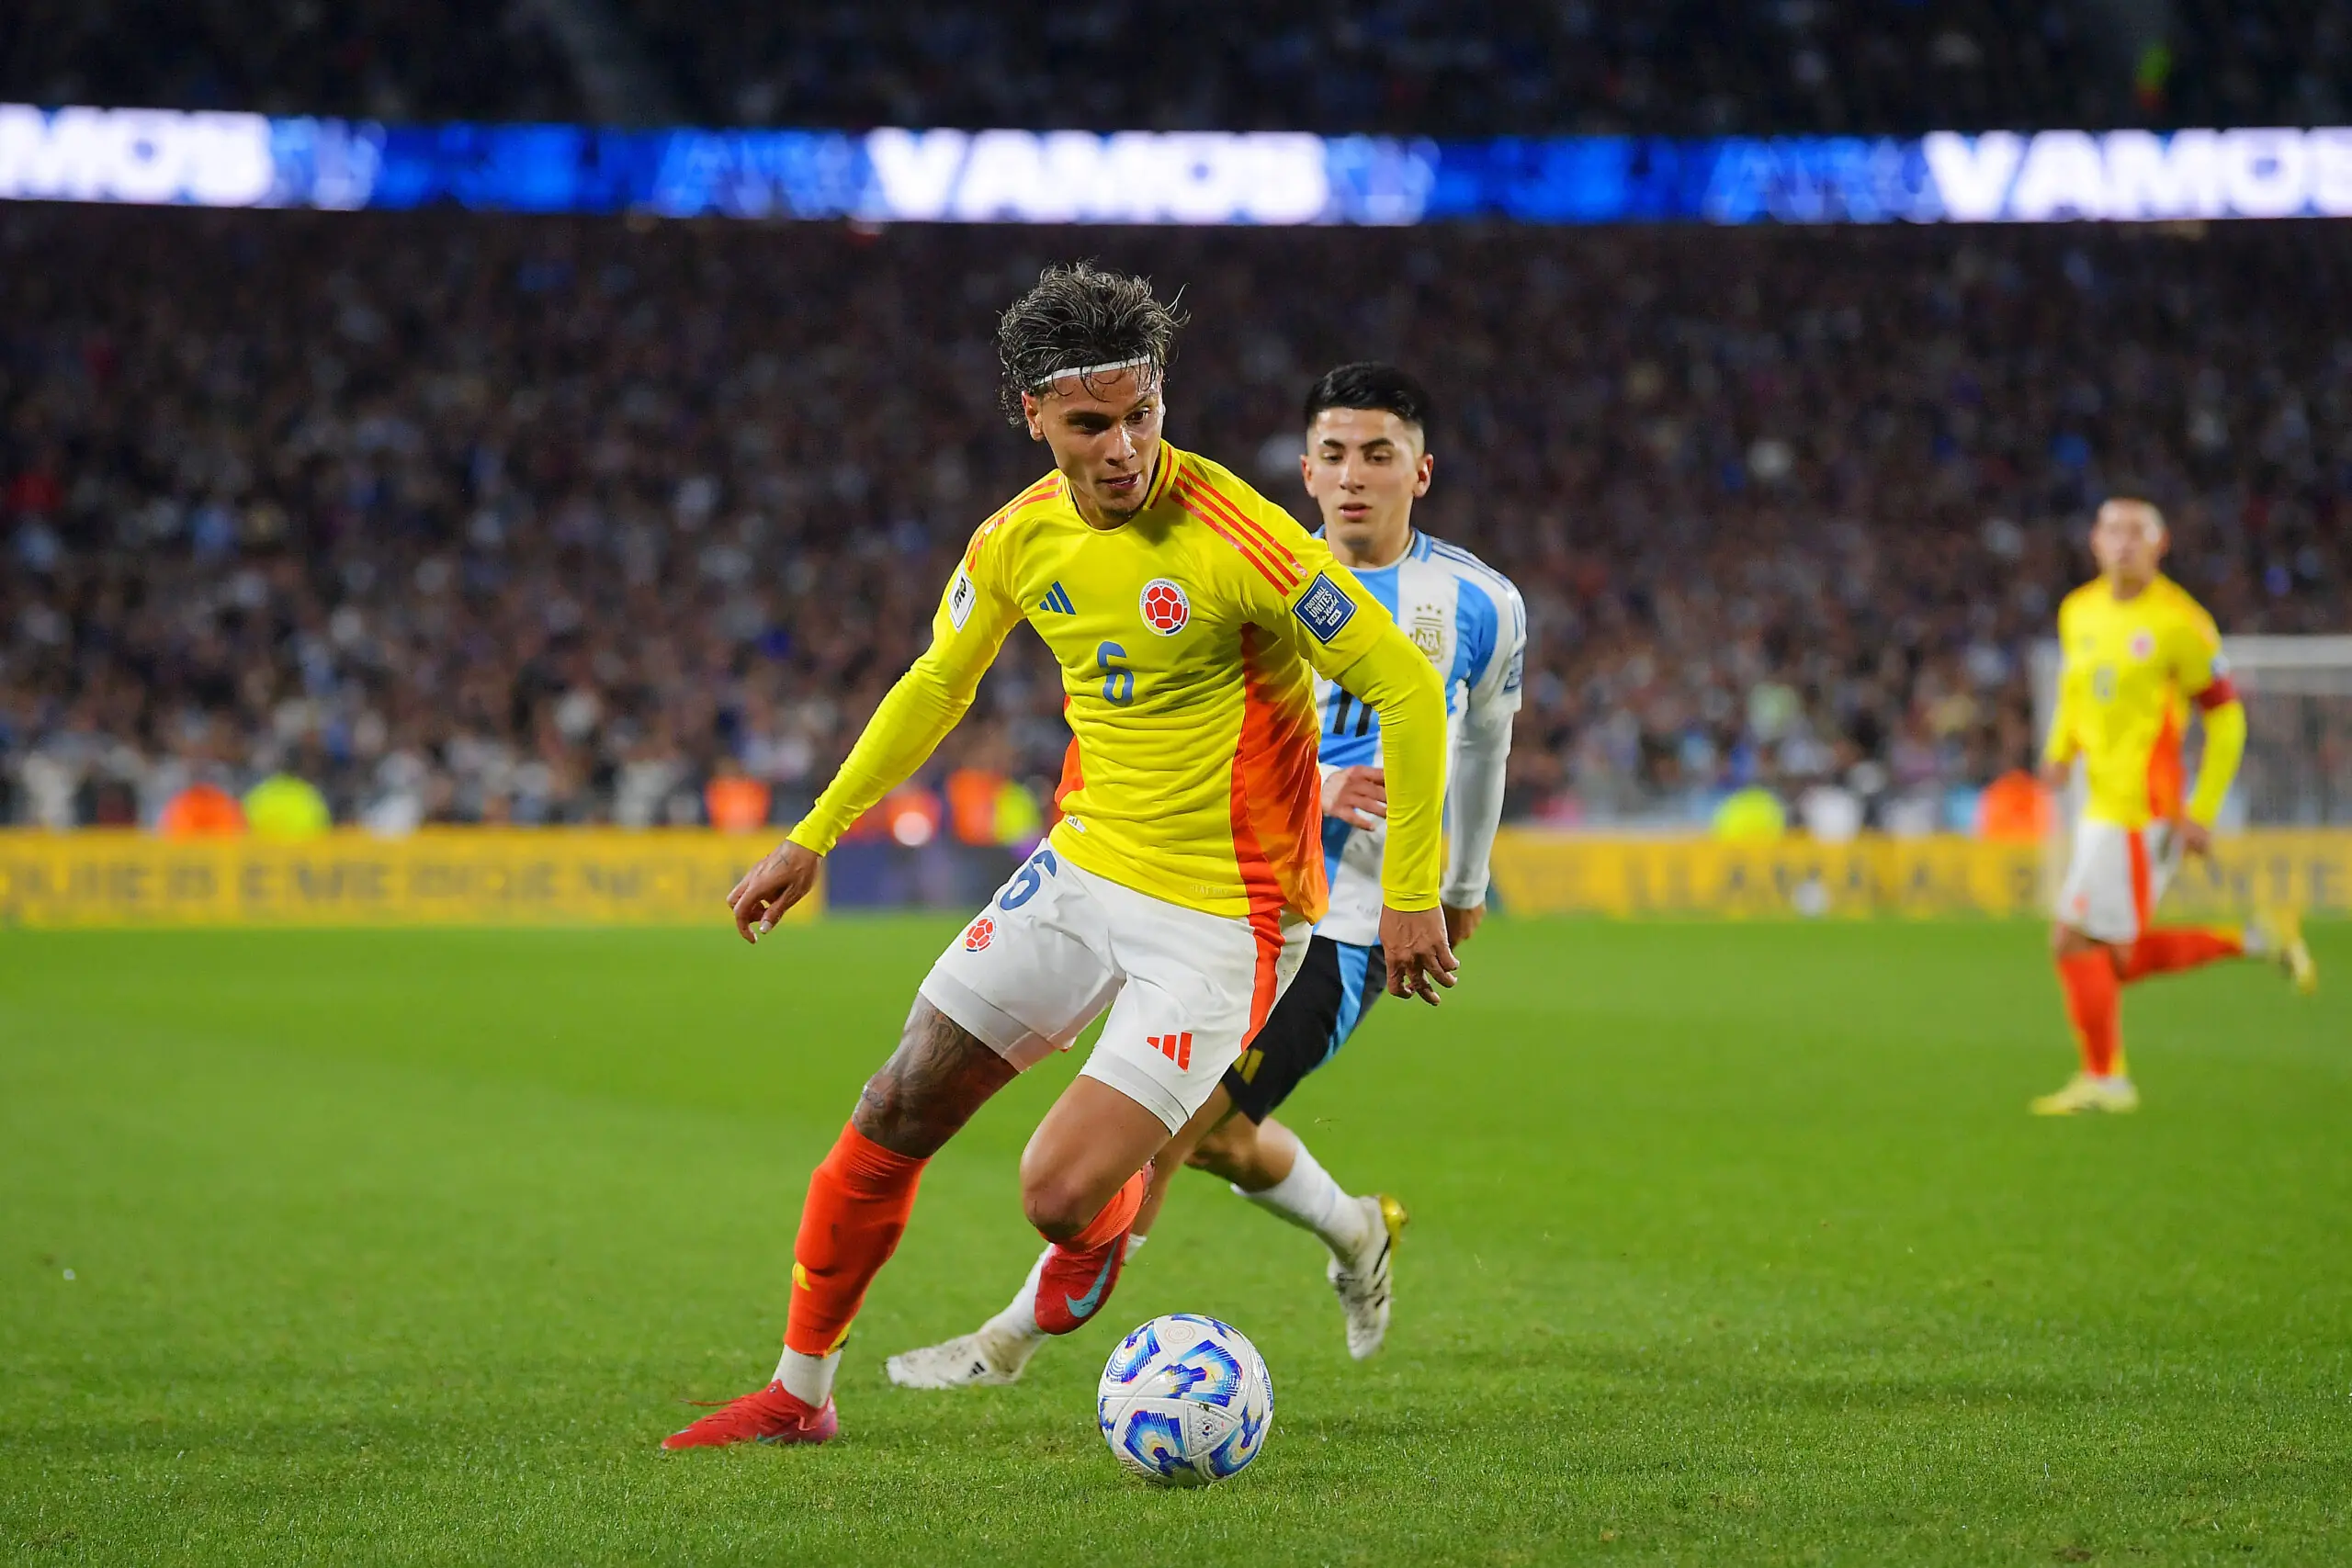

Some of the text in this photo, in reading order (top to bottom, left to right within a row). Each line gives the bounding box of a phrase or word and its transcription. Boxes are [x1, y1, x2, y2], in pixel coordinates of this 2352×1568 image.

[865, 127, 1329, 224] VAMOS
[1304, 586, 1327, 613] FOOTBALL
[1308, 590, 1333, 618] UNITES
[1097, 640, 1135, 706] 6
[999, 849, 1057, 911] 6
